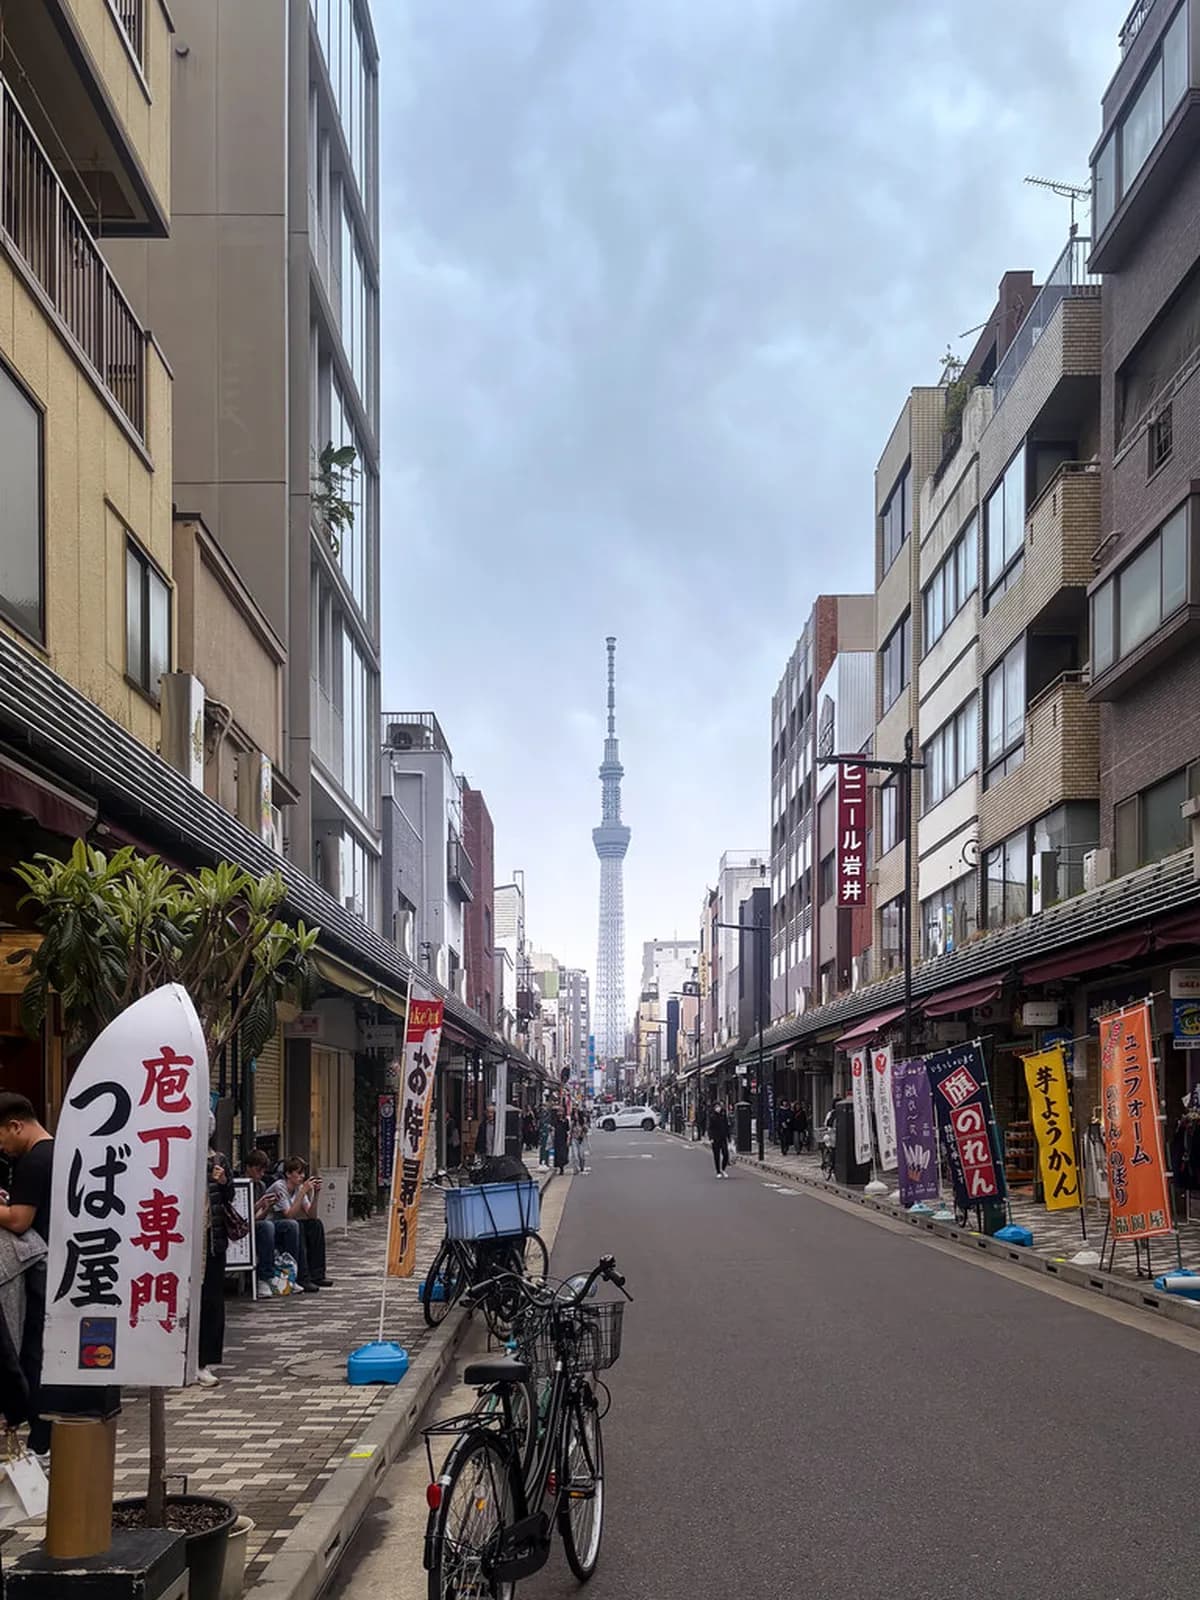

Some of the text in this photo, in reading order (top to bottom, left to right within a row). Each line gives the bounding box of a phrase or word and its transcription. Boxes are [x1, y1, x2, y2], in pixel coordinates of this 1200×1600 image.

[53, 1080, 132, 1308] つば屋
[129, 1045, 195, 1330] 庖丁専門
[956, 1108, 995, 1196] のれん
[1033, 1065, 1078, 1198] 芋ようかん
